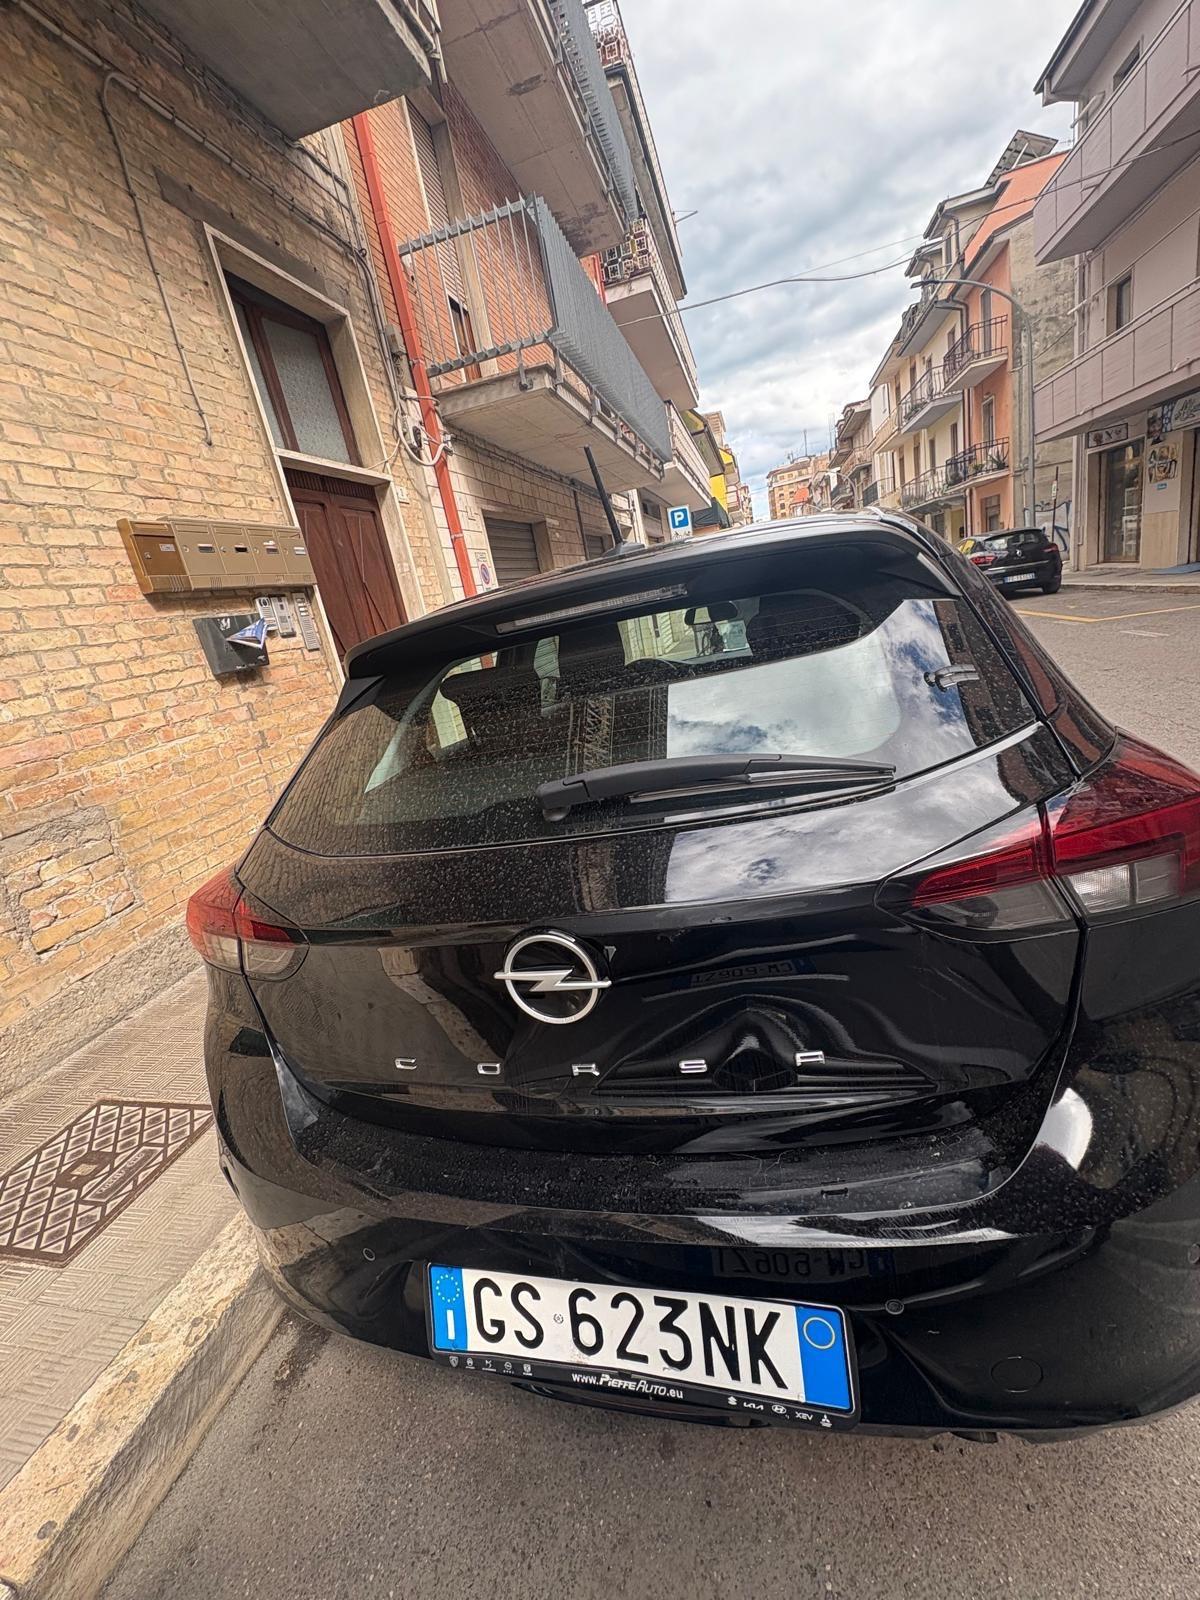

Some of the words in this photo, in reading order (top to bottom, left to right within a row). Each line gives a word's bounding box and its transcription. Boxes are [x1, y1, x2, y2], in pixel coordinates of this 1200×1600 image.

[673, 511, 685, 526] P
[394, 1050, 826, 1077] CORSA
[473, 1277, 544, 1350] GS
[568, 1287, 790, 1390] 623NK
[795, 1411, 813, 1421] XEV
